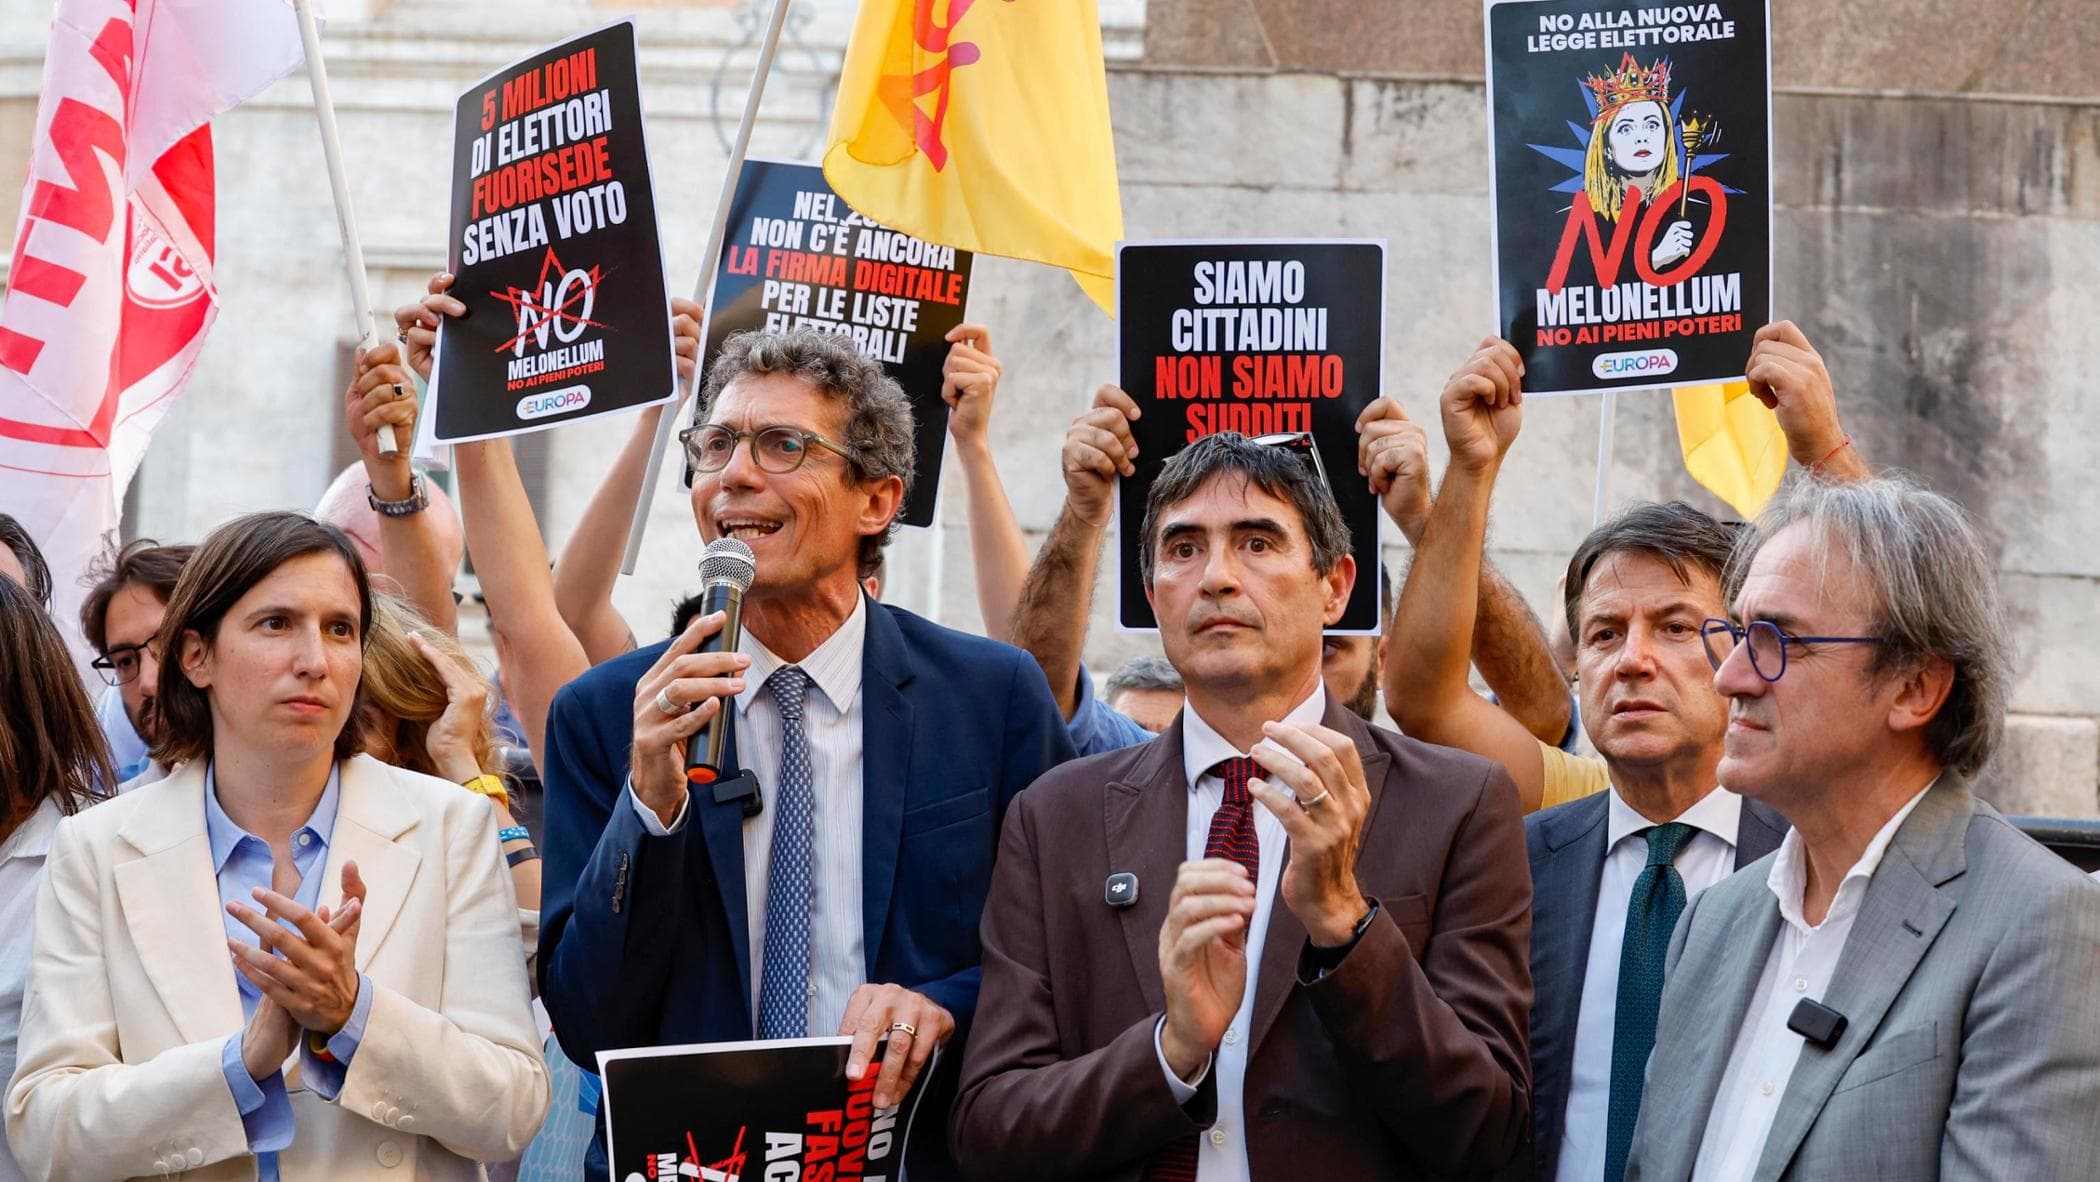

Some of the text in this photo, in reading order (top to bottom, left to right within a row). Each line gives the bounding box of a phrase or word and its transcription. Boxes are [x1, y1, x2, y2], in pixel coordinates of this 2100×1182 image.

[1527, 21, 1735, 52] LEGGE ELETTORALE
[1539, 3, 1722, 33] NO ALLA NUOVA
[481, 48, 597, 131] 5 MILIONI
[471, 89, 612, 179] DI ELETTORI
[472, 136, 612, 220] FUORISEDE
[462, 181, 627, 266] SENZA VOTO
[793, 191, 838, 223] NEL
[750, 217, 804, 250] NON
[854, 228, 956, 271] ANCORA
[1546, 175, 1727, 296] NO
[727, 245, 963, 305] LA FIRMA DIGITALE
[1194, 260, 1305, 304] SIAMO
[1536, 272, 1741, 327] MELONELLUM
[514, 268, 594, 358] NO
[761, 280, 920, 332] PER LE LISTE
[1172, 308, 1328, 352] CITTADINI
[1536, 313, 1741, 347] NO AI PIENI POTERI
[507, 340, 604, 381] MELONELLUM
[507, 361, 605, 392] NO AI PIENI POTERI
[1156, 355, 1344, 399] NON SIAMO
[1186, 402, 1312, 445] SUDDITI
[867, 1104, 900, 1161] NO
